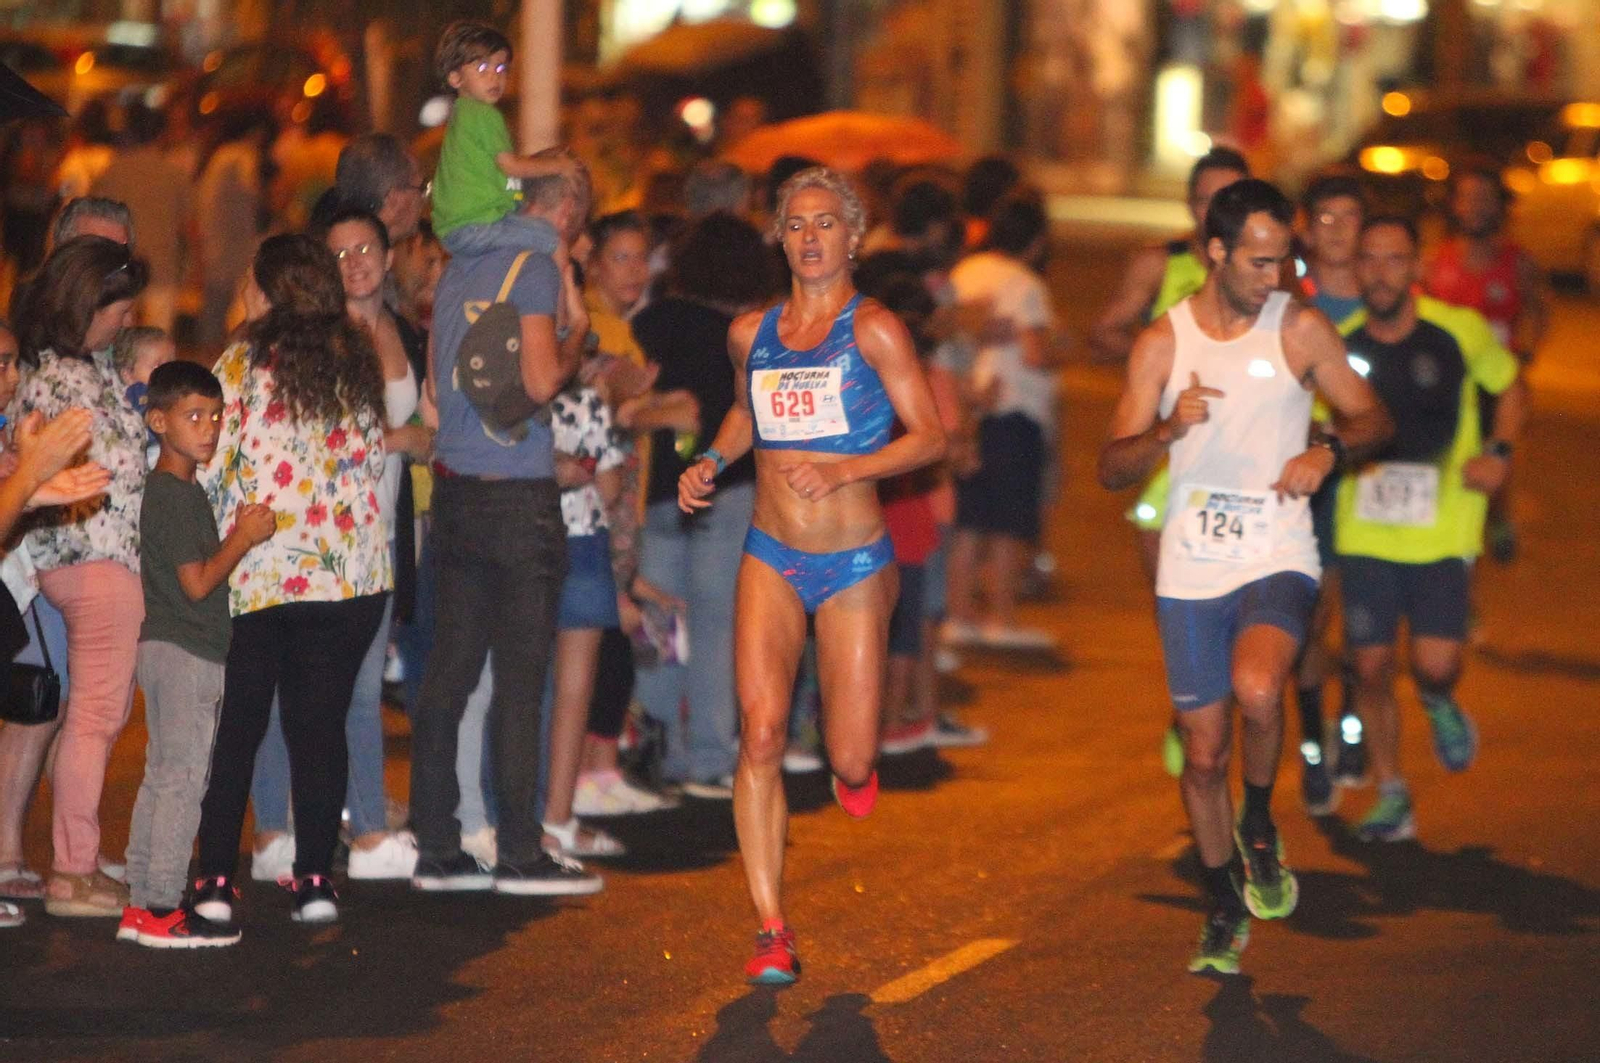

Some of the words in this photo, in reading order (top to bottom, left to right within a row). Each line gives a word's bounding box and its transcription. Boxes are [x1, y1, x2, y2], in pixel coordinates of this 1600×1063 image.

[780, 371, 829, 380] NOCTURNA
[792, 380, 827, 390] HUELVA
[771, 391, 815, 418] 629
[1197, 510, 1243, 540] 124
